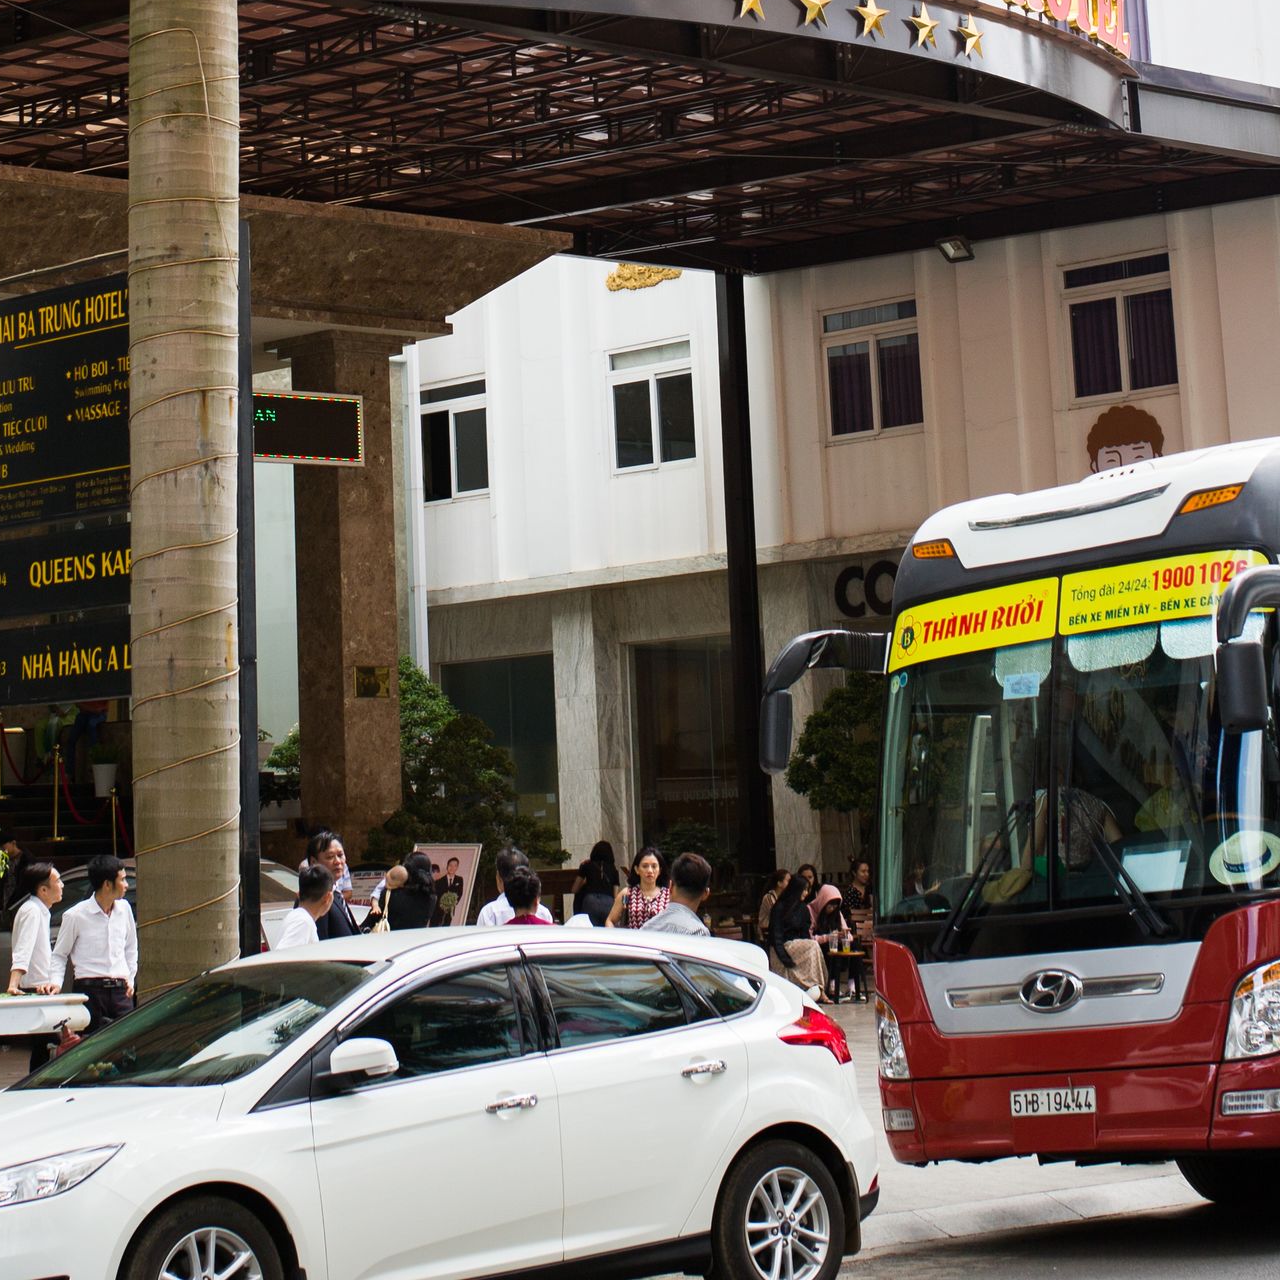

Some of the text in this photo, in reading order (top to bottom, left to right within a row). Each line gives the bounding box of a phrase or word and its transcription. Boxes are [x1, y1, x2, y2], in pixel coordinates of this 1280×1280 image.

[19, 310, 35, 340] BA
[38, 299, 81, 334] TRUNG
[75, 400, 121, 422] MASSAGE
[5, 441, 35, 454] Wedding
[29, 553, 95, 588] QUEENS
[1099, 583, 1115, 597] đài
[1152, 564, 1195, 592] 1900
[923, 605, 990, 644] THÀNH
[1091, 612, 1102, 622] XE
[1184, 596, 1197, 609] XE
[22, 645, 54, 680] NHÀ
[59, 642, 102, 676] HÀNG
